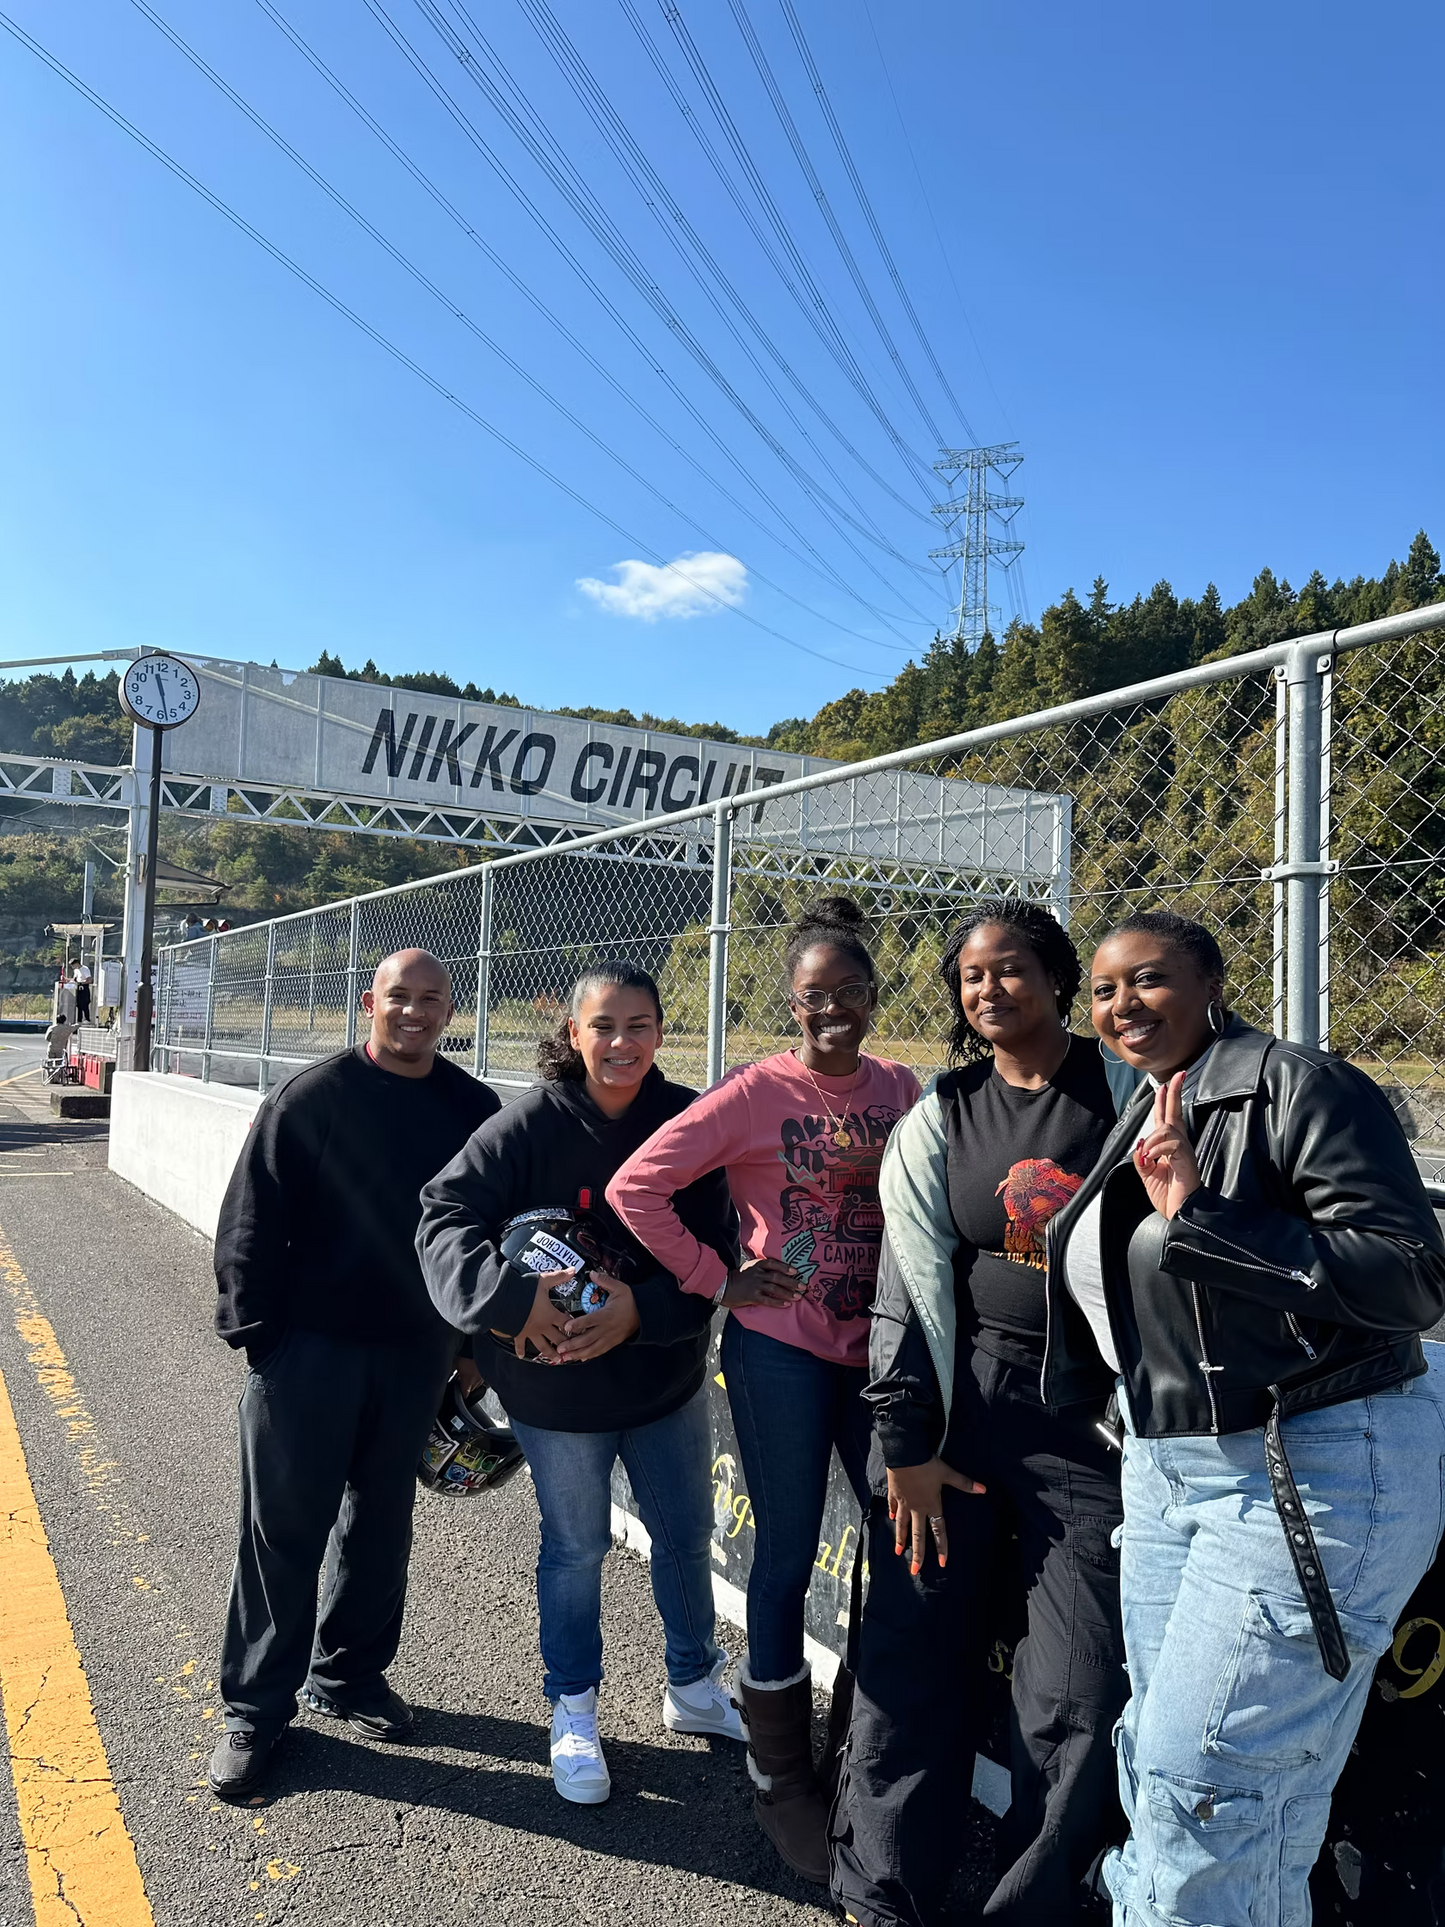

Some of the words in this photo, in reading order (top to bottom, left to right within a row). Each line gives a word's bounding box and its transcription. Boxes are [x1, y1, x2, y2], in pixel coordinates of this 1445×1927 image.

[144, 664, 154, 674] 11
[156, 662, 169, 673] 12
[134, 672, 147, 682] 10
[173, 669, 178, 678] 1
[131, 683, 139, 692] 9
[180, 678, 188, 687] 2
[135, 695, 143, 705] 8
[183, 690, 191, 700] 3
[145, 705, 153, 715] 7
[178, 702, 186, 711] 4
[156, 710, 164, 720] 6
[169, 708, 177, 718] 5
[362, 708, 556, 796] NIKKO
[570, 741, 785, 824] CIRCUIT
[536, 1236, 580, 1267] PHATCHOP
[824, 1244, 866, 1265] CAMP
